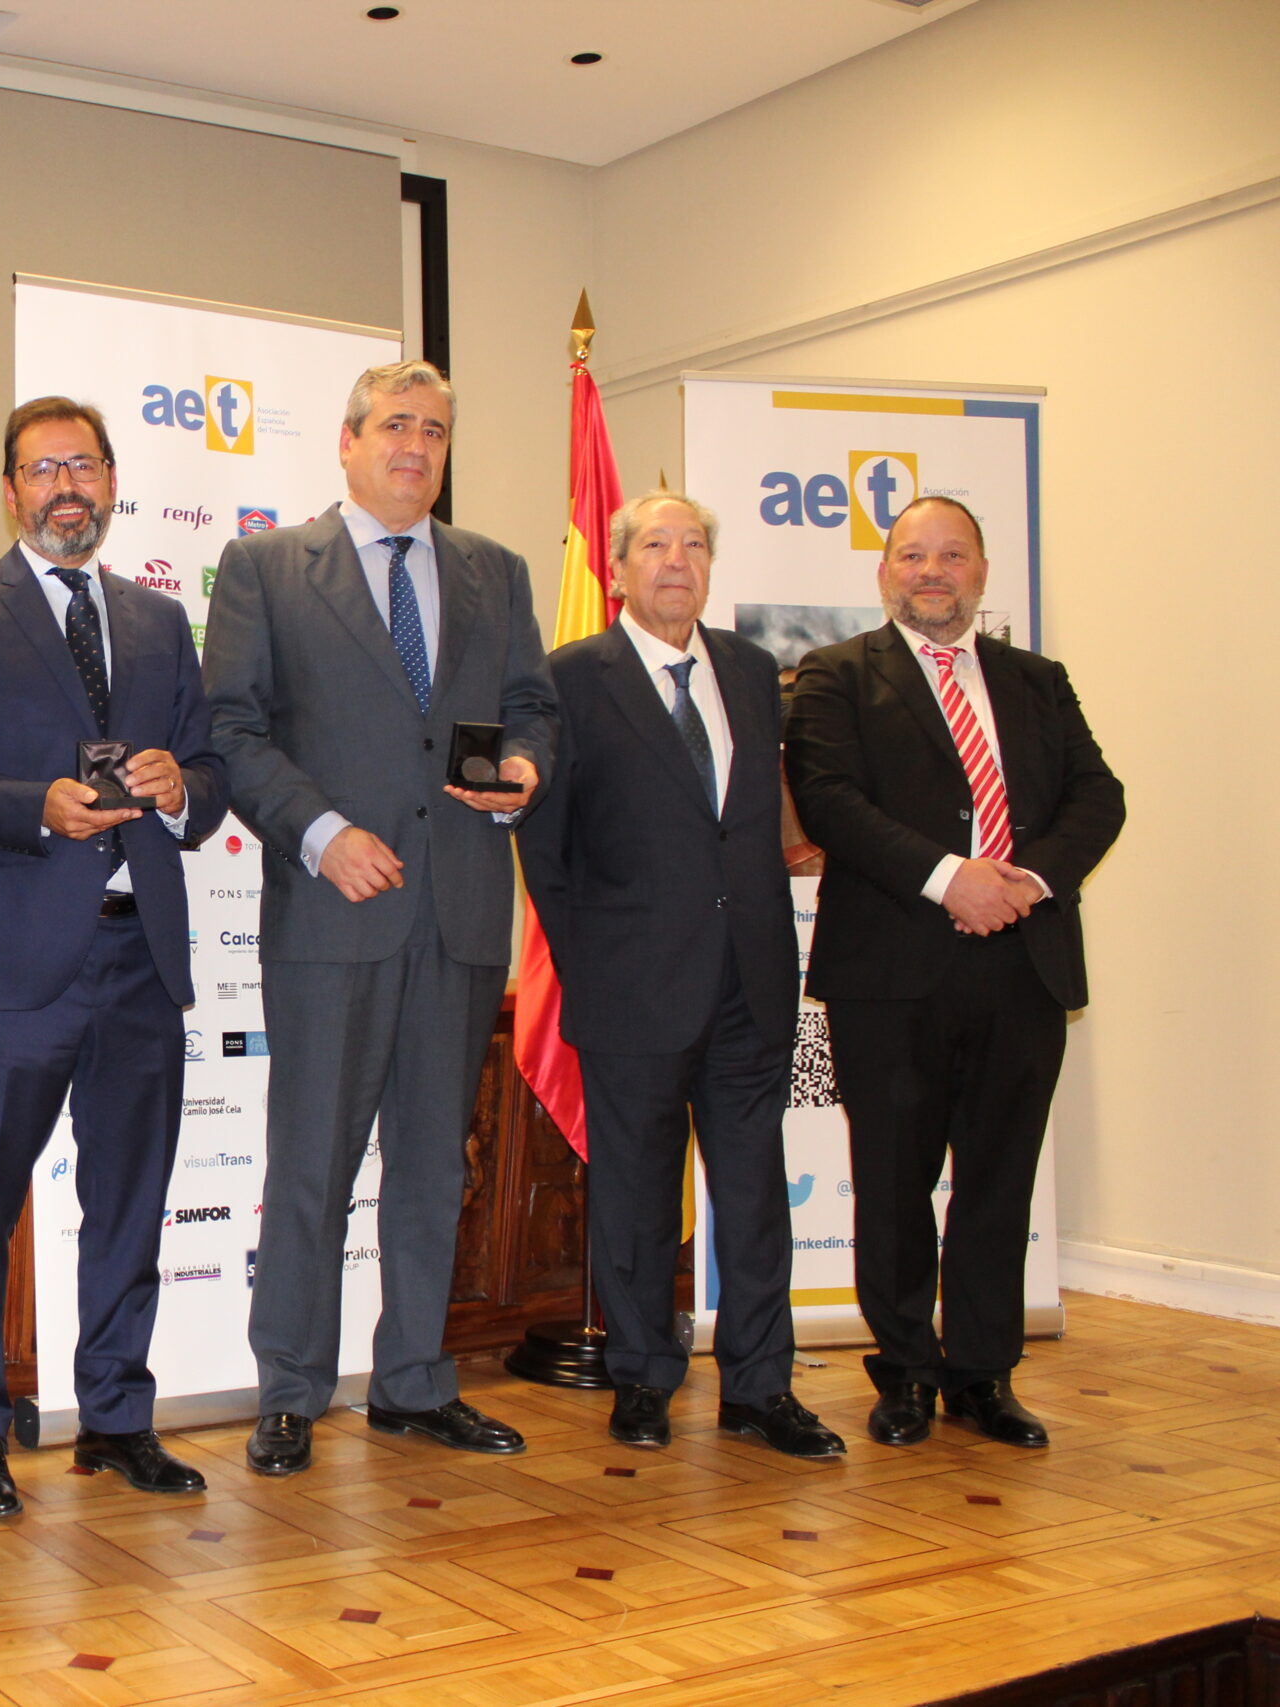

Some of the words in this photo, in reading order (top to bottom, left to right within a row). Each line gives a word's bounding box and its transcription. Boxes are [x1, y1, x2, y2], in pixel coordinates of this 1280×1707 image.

[142, 384, 239, 438] aet
[760, 458, 897, 530] aet
[923, 487, 969, 497] Asociación
[111, 500, 139, 515] dif
[163, 505, 213, 531] renfe
[247, 520, 266, 529] Metro
[135, 576, 182, 591] MAFEX
[210, 889, 243, 899] PONS
[242, 982, 263, 990] mart
[183, 1096, 226, 1107] Universidad
[183, 1107, 208, 1116] Camilo
[209, 1106, 224, 1115] José
[226, 1105, 242, 1114] Cela
[184, 1153, 253, 1169] visualTrans
[175, 1206, 231, 1224] SIMFOR
[345, 1247, 379, 1261] ralco
[174, 1268, 221, 1278] INDUSTRIALES
